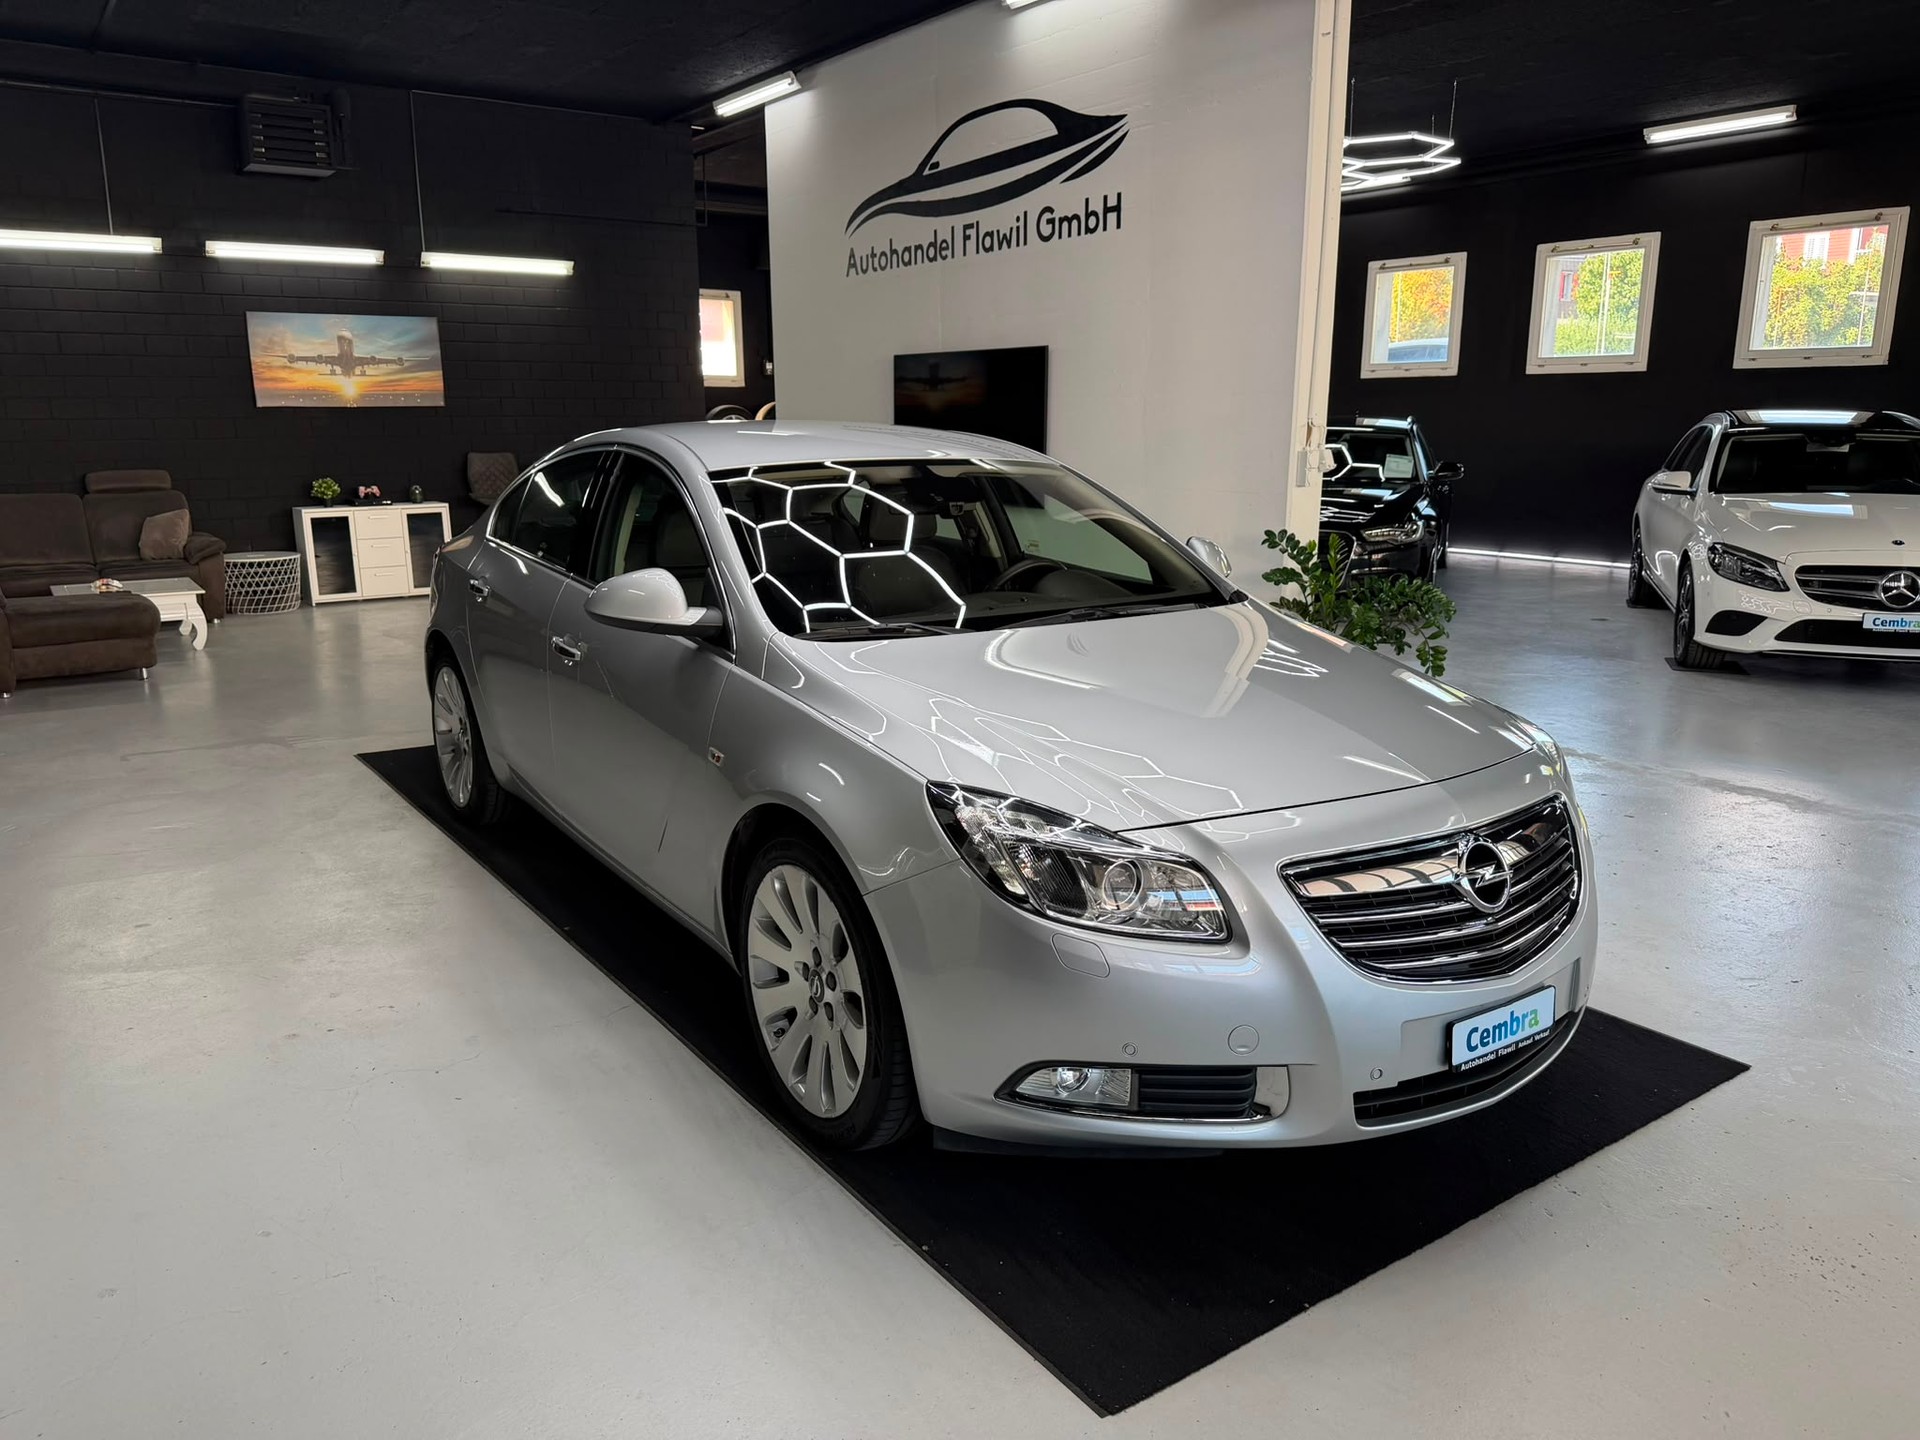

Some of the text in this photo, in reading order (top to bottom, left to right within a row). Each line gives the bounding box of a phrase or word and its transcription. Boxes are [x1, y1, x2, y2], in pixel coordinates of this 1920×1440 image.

[846, 192, 1122, 277] Autohandel Flawil GmbH
[1872, 617, 1920, 628] Cembra
[1466, 1009, 1540, 1052] Cembra
[1460, 1052, 1497, 1071] Autohandel
[1498, 1043, 1516, 1056] Flawil
